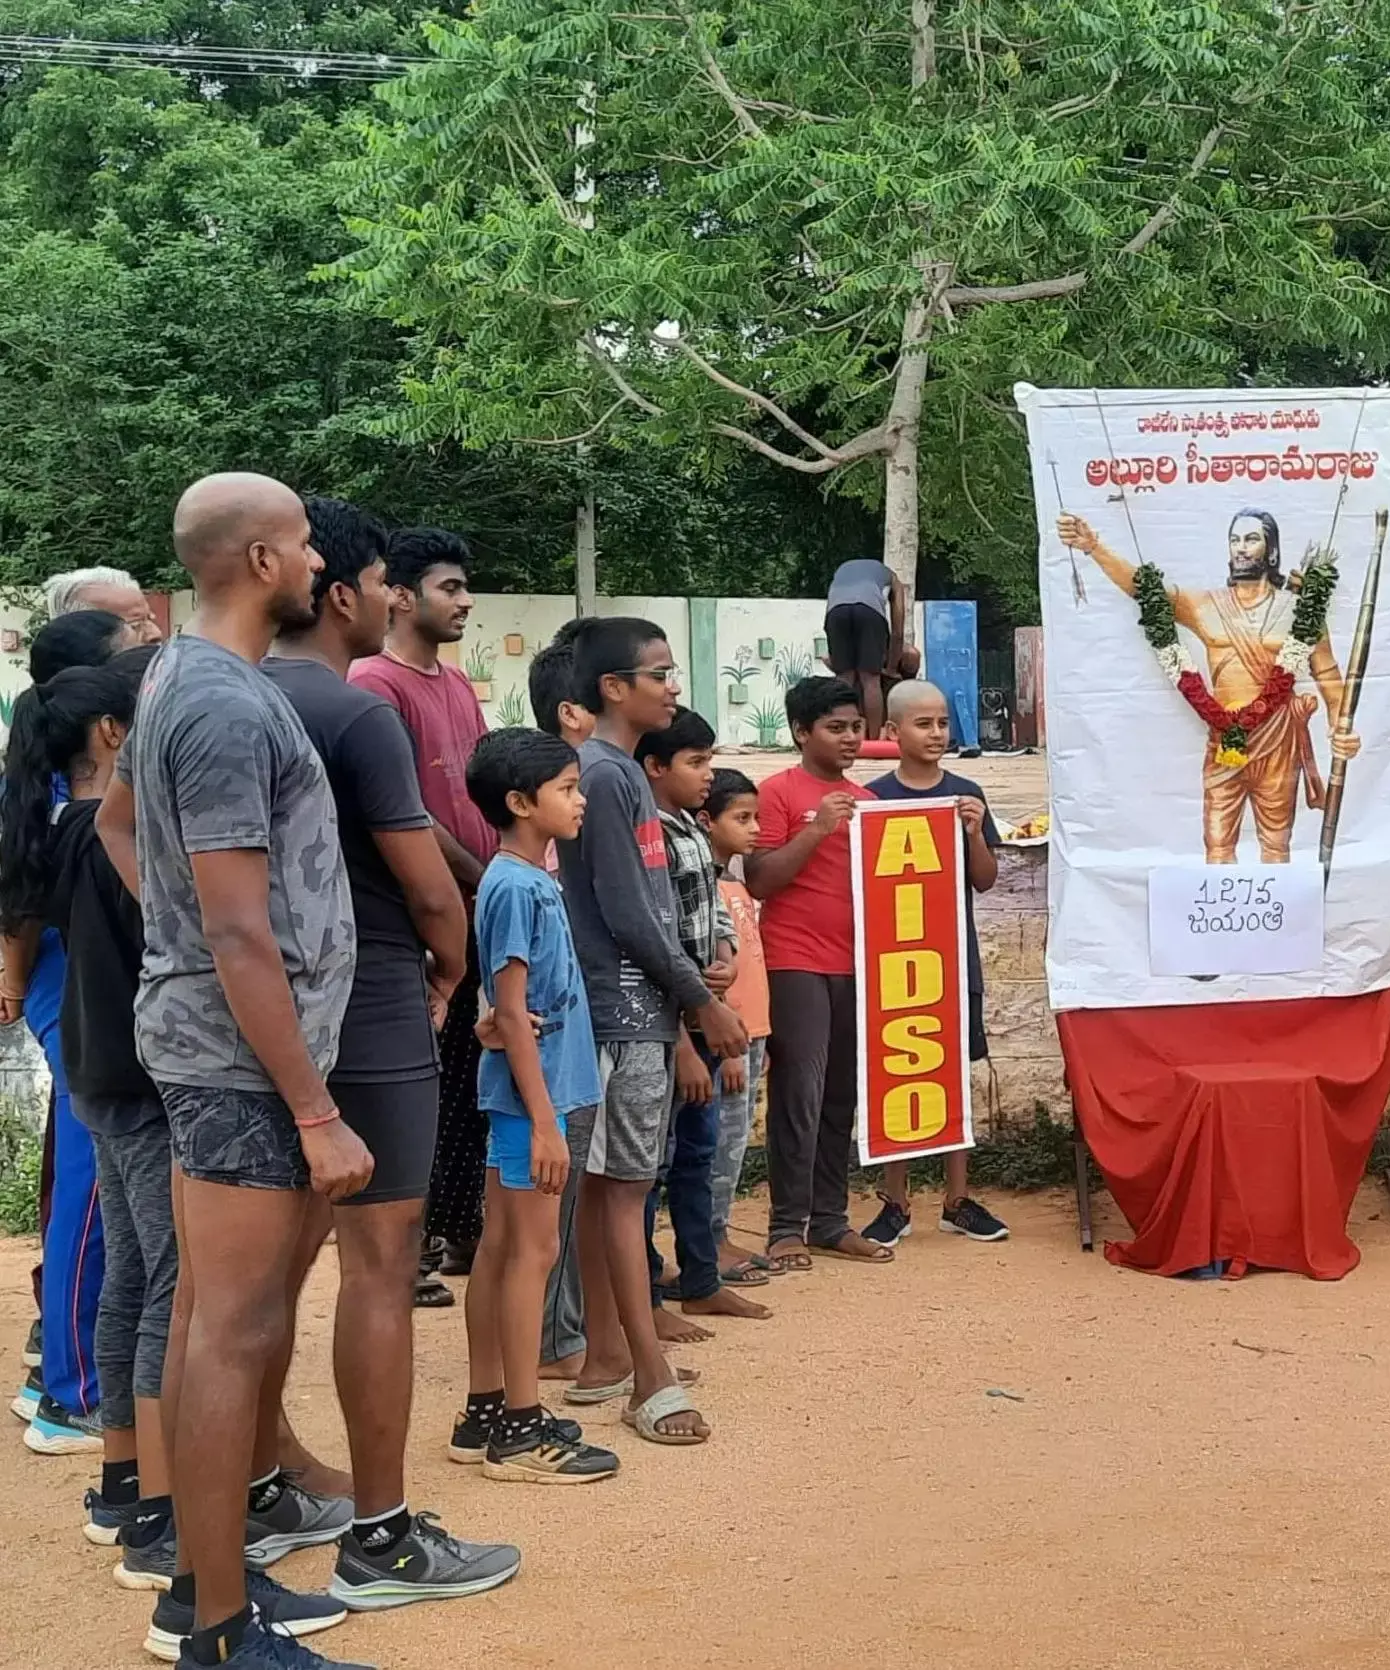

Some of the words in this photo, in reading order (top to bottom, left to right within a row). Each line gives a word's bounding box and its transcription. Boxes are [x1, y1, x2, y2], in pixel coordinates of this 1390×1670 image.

[1086, 456, 1178, 493] అల్లూరి
[1186, 442, 1379, 483] సీతారామరాజు
[1194, 877, 1276, 905] 127వ
[1188, 901, 1284, 934] జయంతి
[874, 815, 947, 1143] AIDSO
